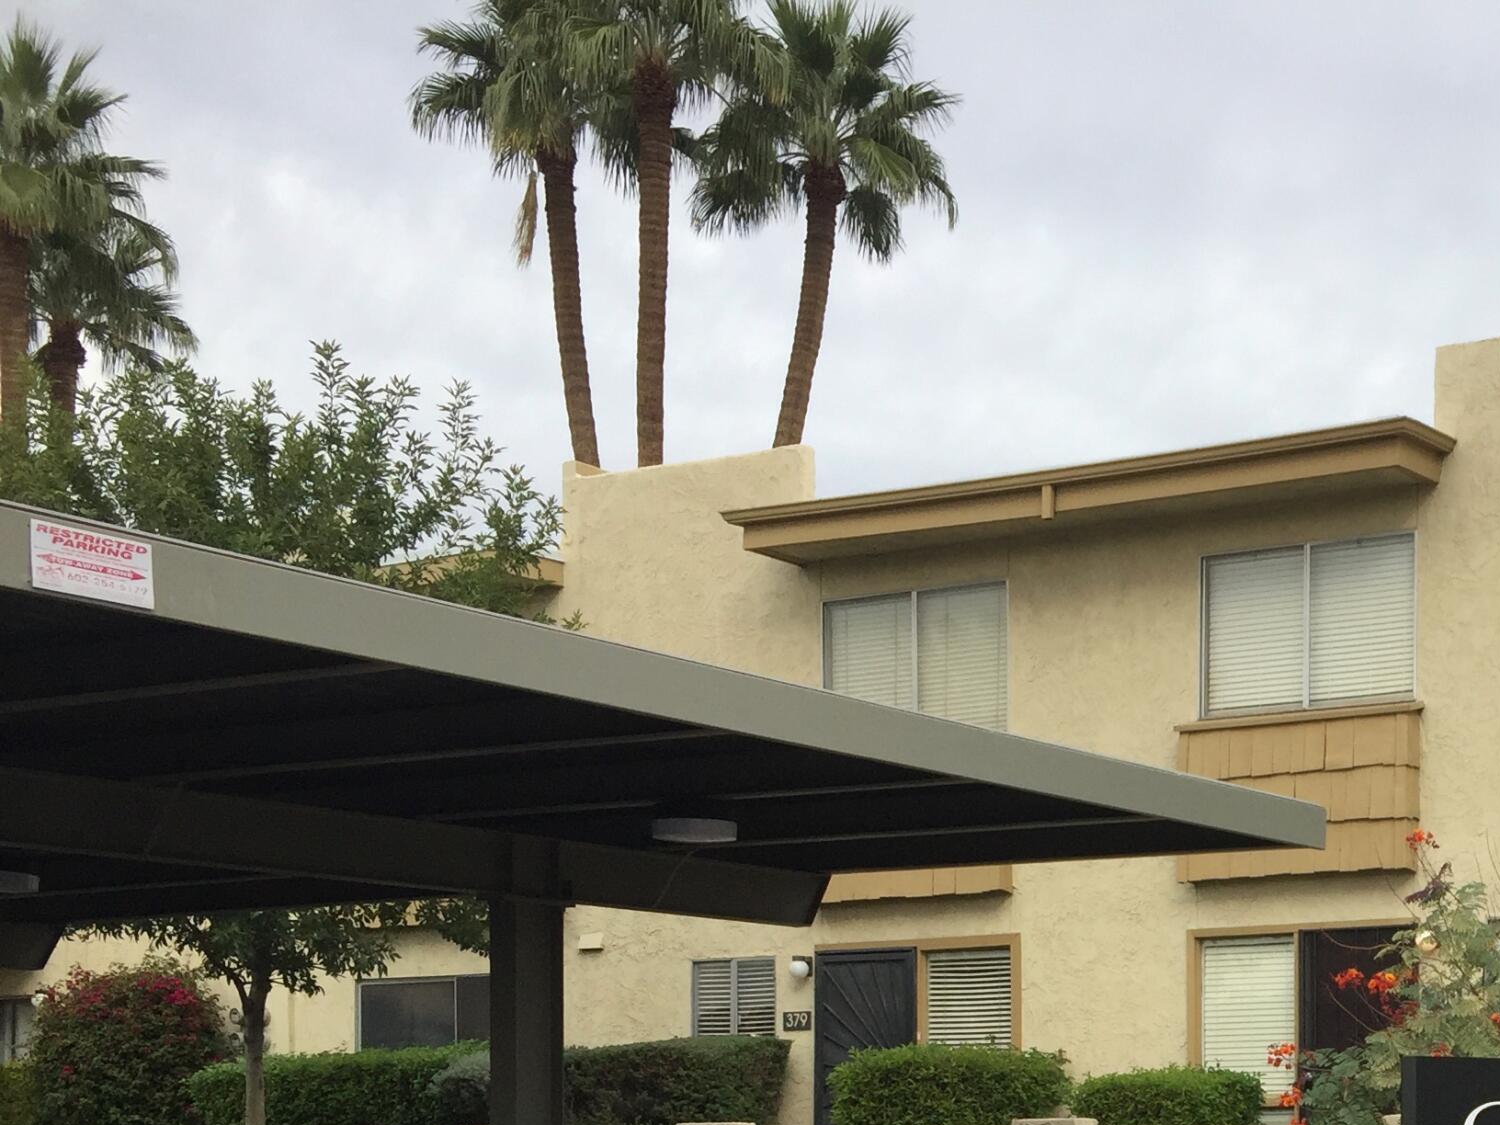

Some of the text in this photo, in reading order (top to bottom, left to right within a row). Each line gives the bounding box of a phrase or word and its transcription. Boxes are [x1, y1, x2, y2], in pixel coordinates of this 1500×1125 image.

[36, 523, 147, 554] RESTRICTED
[52, 536, 132, 560] PARKING
[786, 1012, 808, 1028] 379
